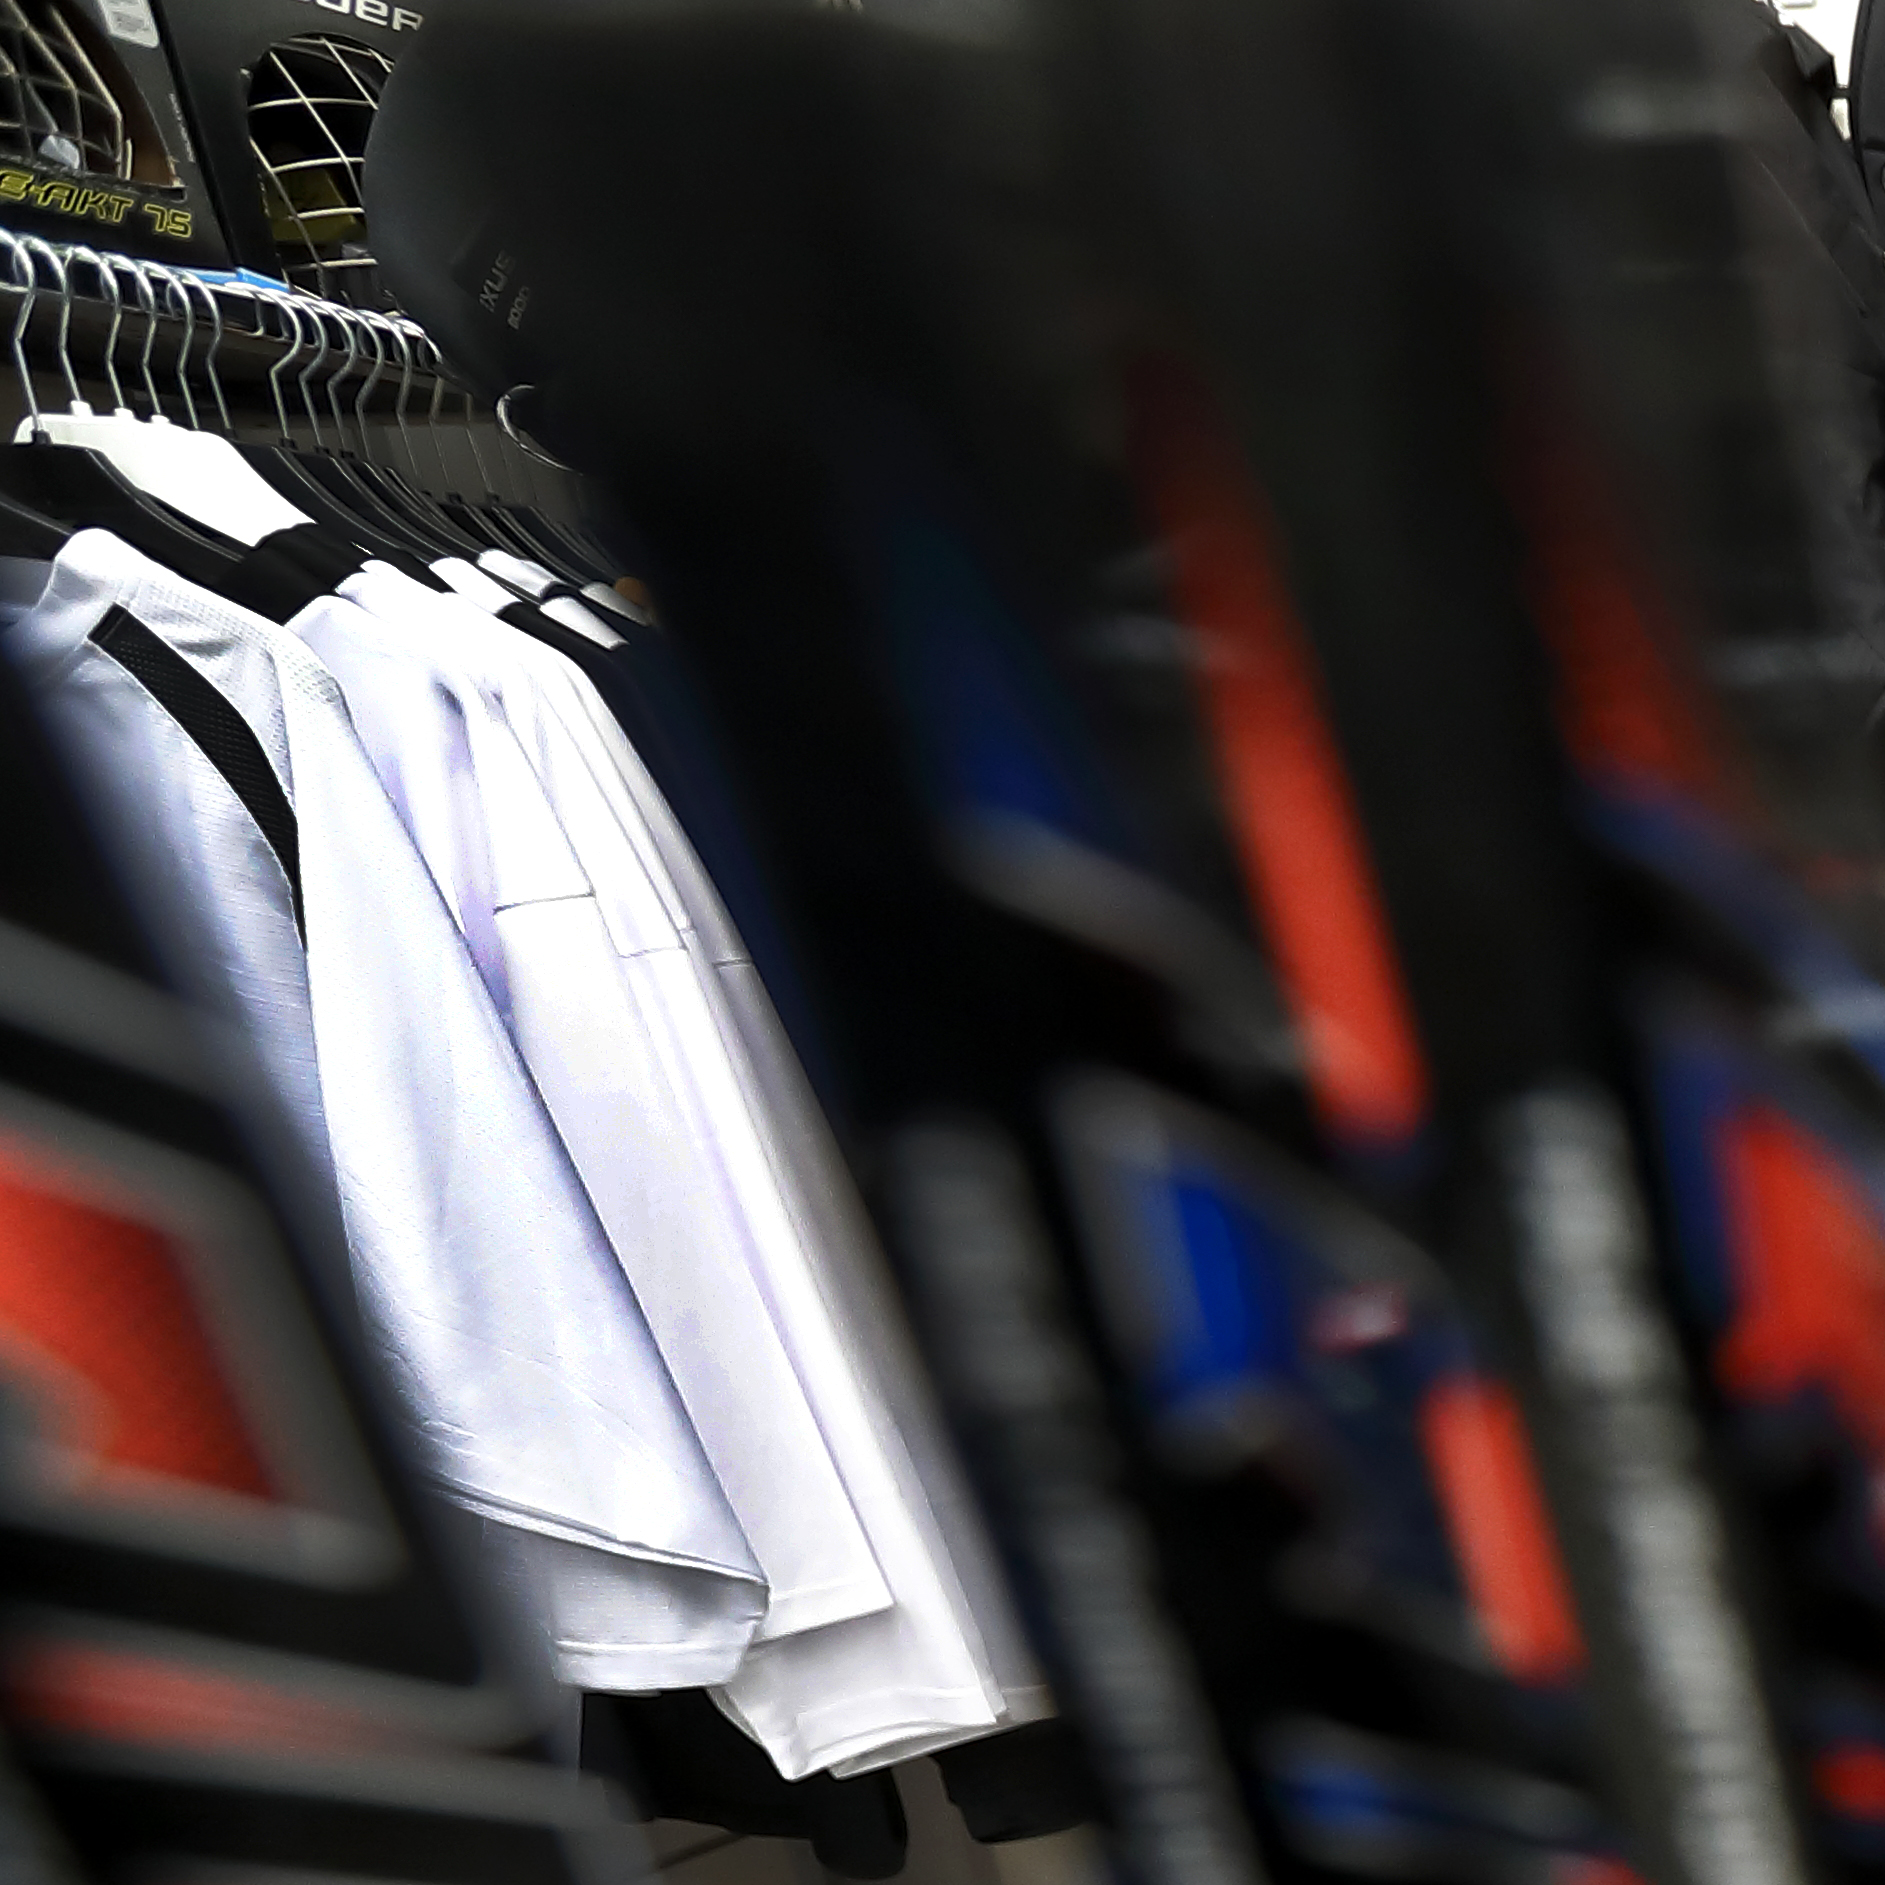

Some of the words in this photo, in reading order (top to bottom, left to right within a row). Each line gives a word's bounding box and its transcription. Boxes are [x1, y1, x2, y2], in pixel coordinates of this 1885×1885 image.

[314, 0, 424, 32] UER
[0, 168, 133, 223] E-AKT
[143, 204, 192, 238] 75
